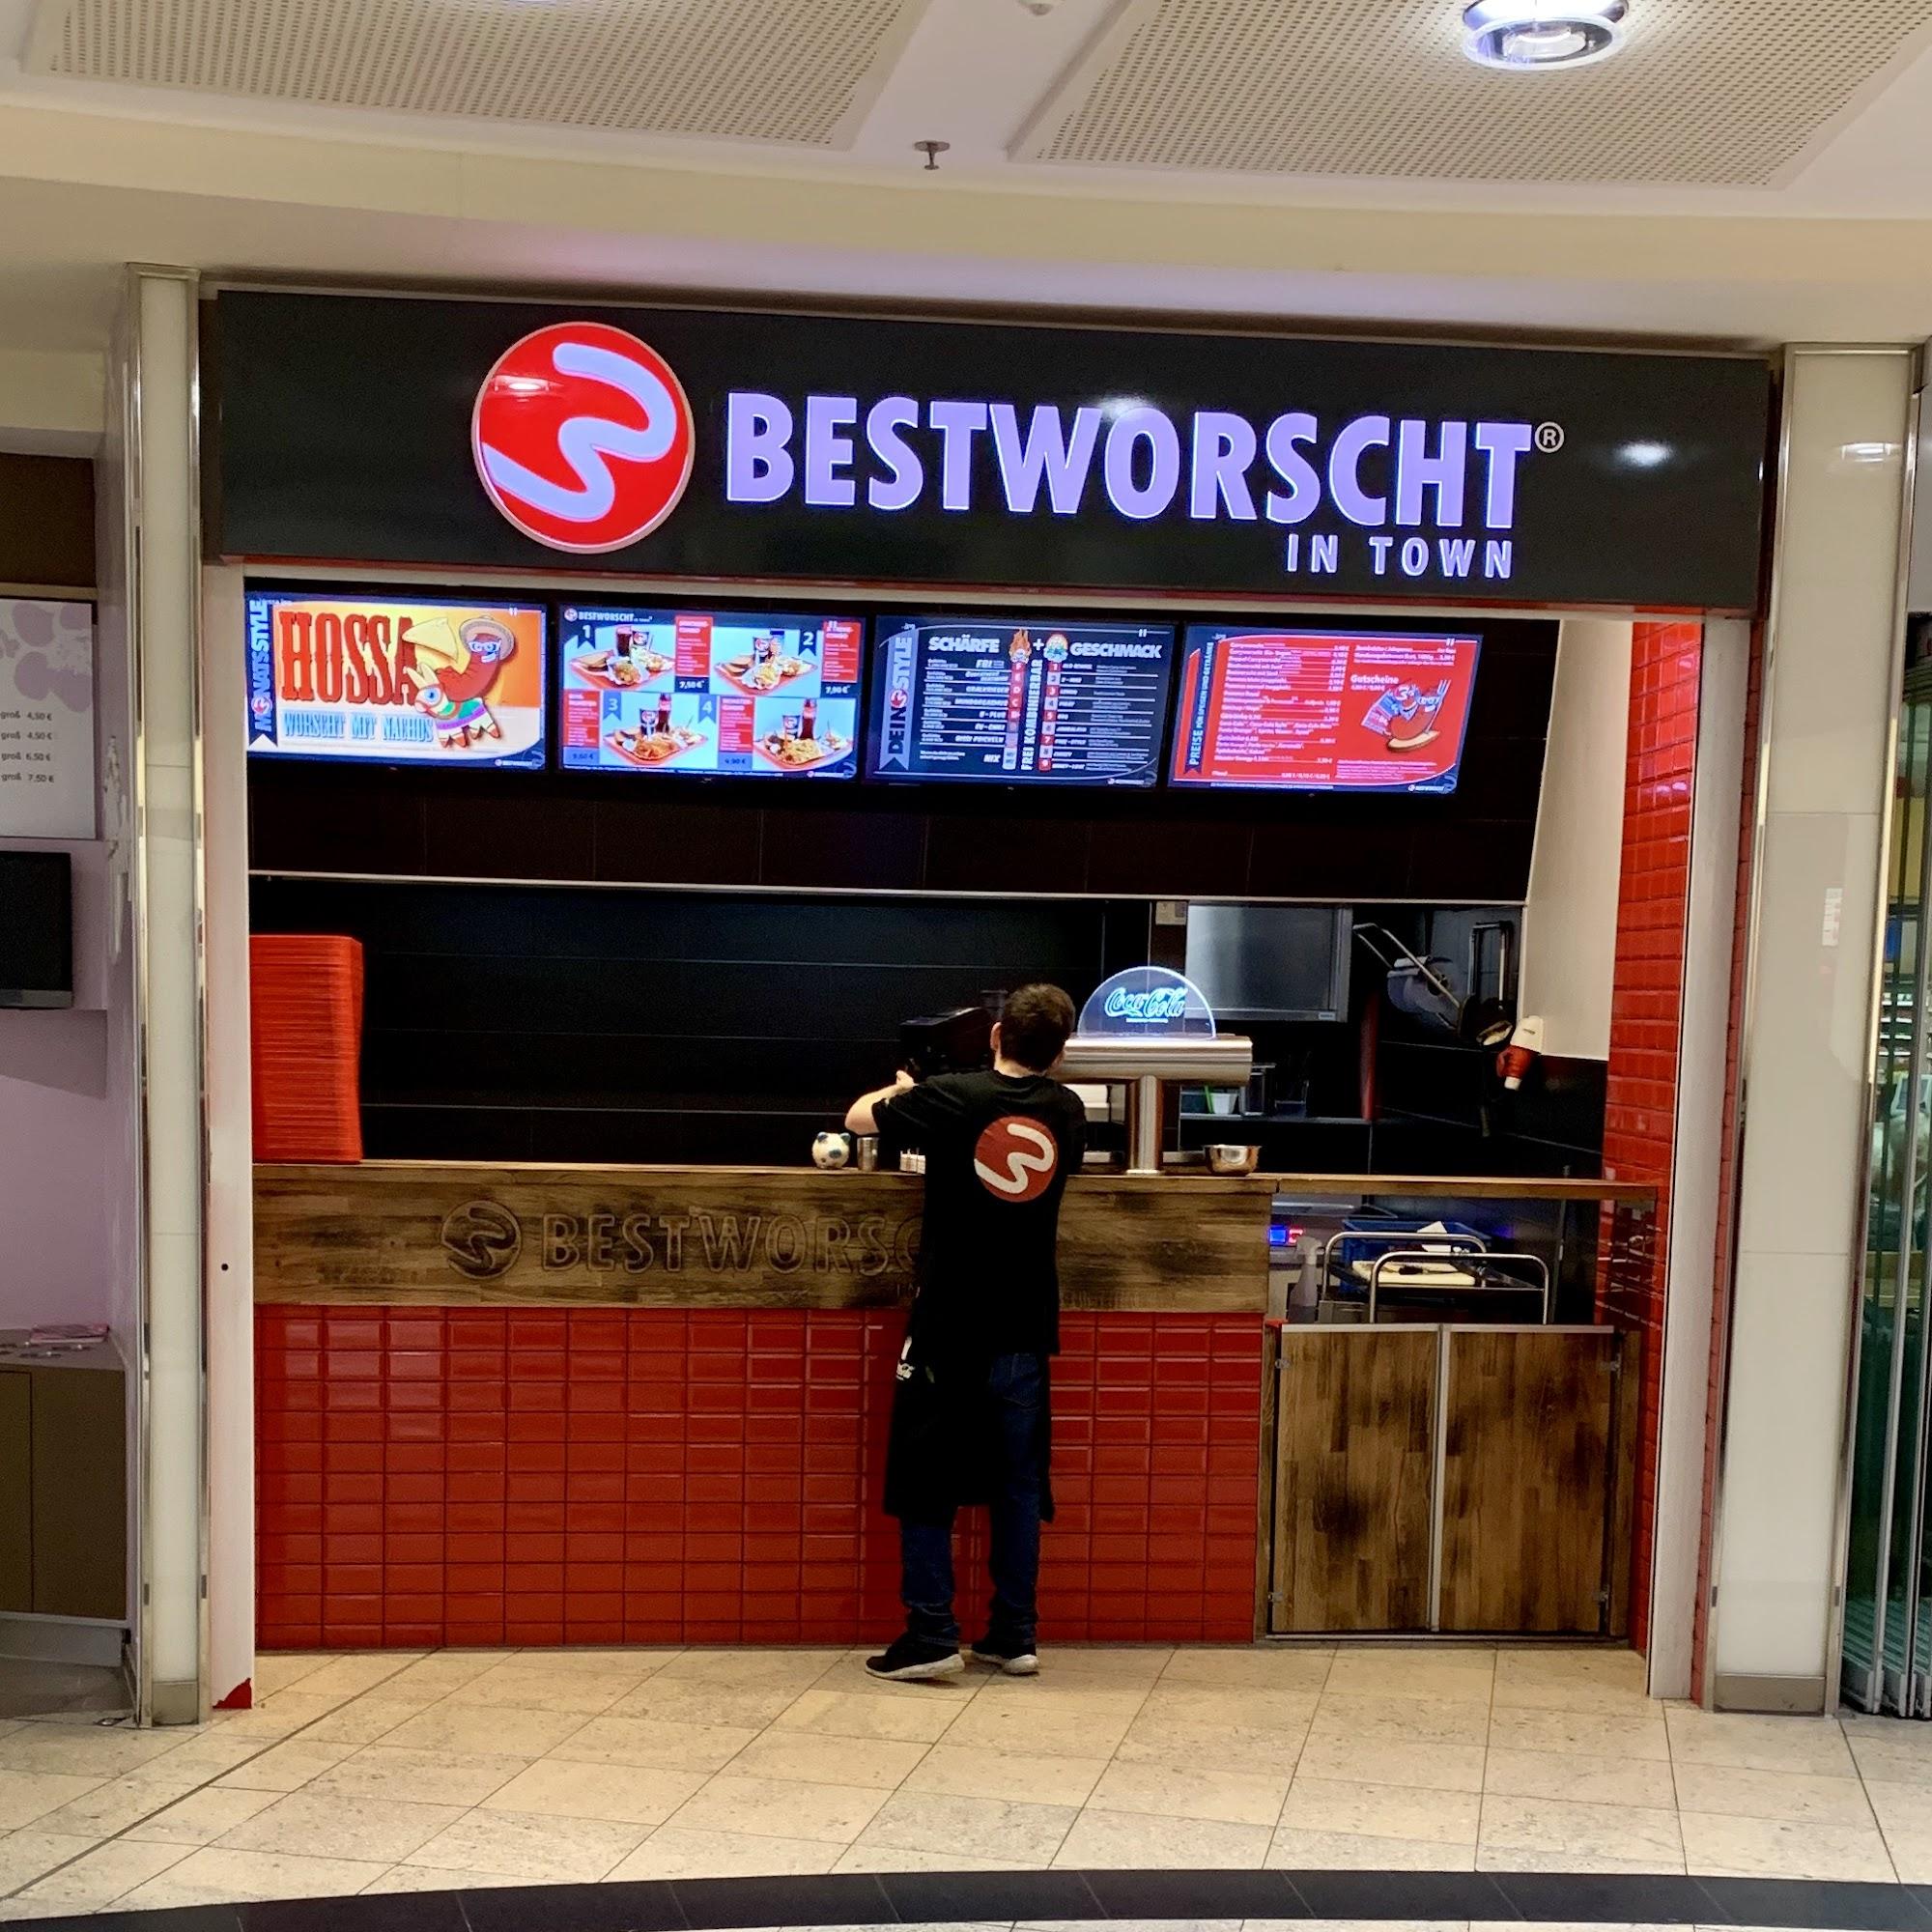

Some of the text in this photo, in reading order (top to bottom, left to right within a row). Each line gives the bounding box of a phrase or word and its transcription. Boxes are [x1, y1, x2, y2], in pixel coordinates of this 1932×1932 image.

[1286, 533, 1513, 580] IN TOWN
[582, 625, 591, 639] 1
[803, 632, 814, 645] 2
[928, 634, 1000, 654] SCHÄRFE
[1070, 641, 1162, 659] GESCHMACK
[278, 611, 418, 706] HOSSA
[893, 637, 913, 690] STYLE
[1350, 674, 1399, 685] Gutscheine
[608, 697, 618, 711] 3
[702, 700, 713, 714] 4
[1021, 659, 1042, 771] FREI KOMBINIERBAR
[350, 713, 377, 740] MIT
[382, 714, 434, 743] NACHOS
[888, 706, 907, 754] DEIN
[1188, 729, 1204, 766] PREISE
[542, 1212, 921, 1278] BESTWORSC
